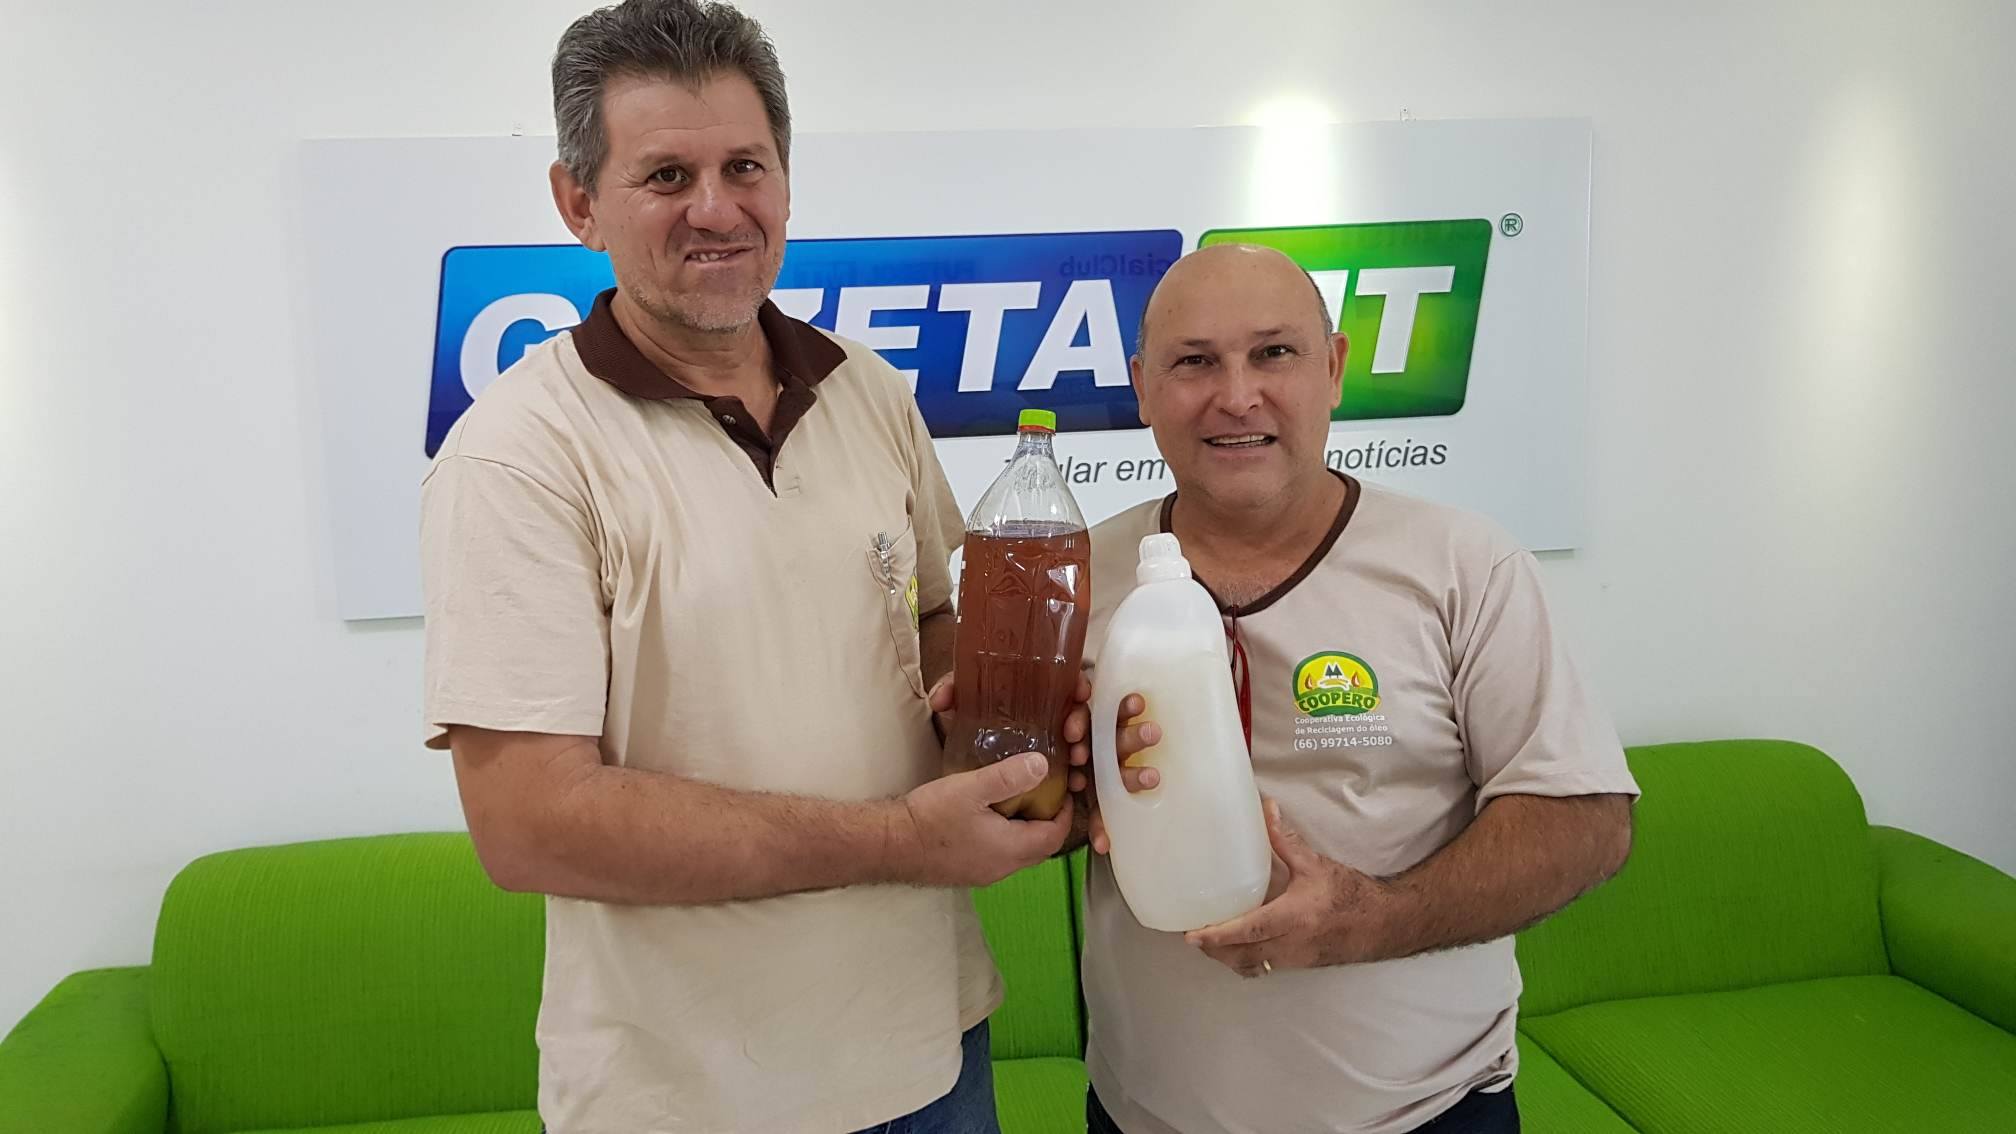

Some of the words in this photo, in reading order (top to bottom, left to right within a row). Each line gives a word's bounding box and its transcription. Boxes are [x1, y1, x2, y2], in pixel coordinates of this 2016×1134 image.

[1115, 458, 1166, 481] em
[1325, 438, 1448, 470] notícias
[1298, 692, 1376, 712] COOPERO
[1295, 714, 1344, 724] Cooperativa
[1345, 712, 1385, 723] Ecológica
[1295, 727, 1305, 735] de
[1307, 725, 1355, 735] Reciclagem
[1356, 724, 1368, 732] do
[1369, 723, 1388, 732] óleo
[1293, 738, 1318, 751] (66)
[1320, 736, 1393, 748] 99714-5080
